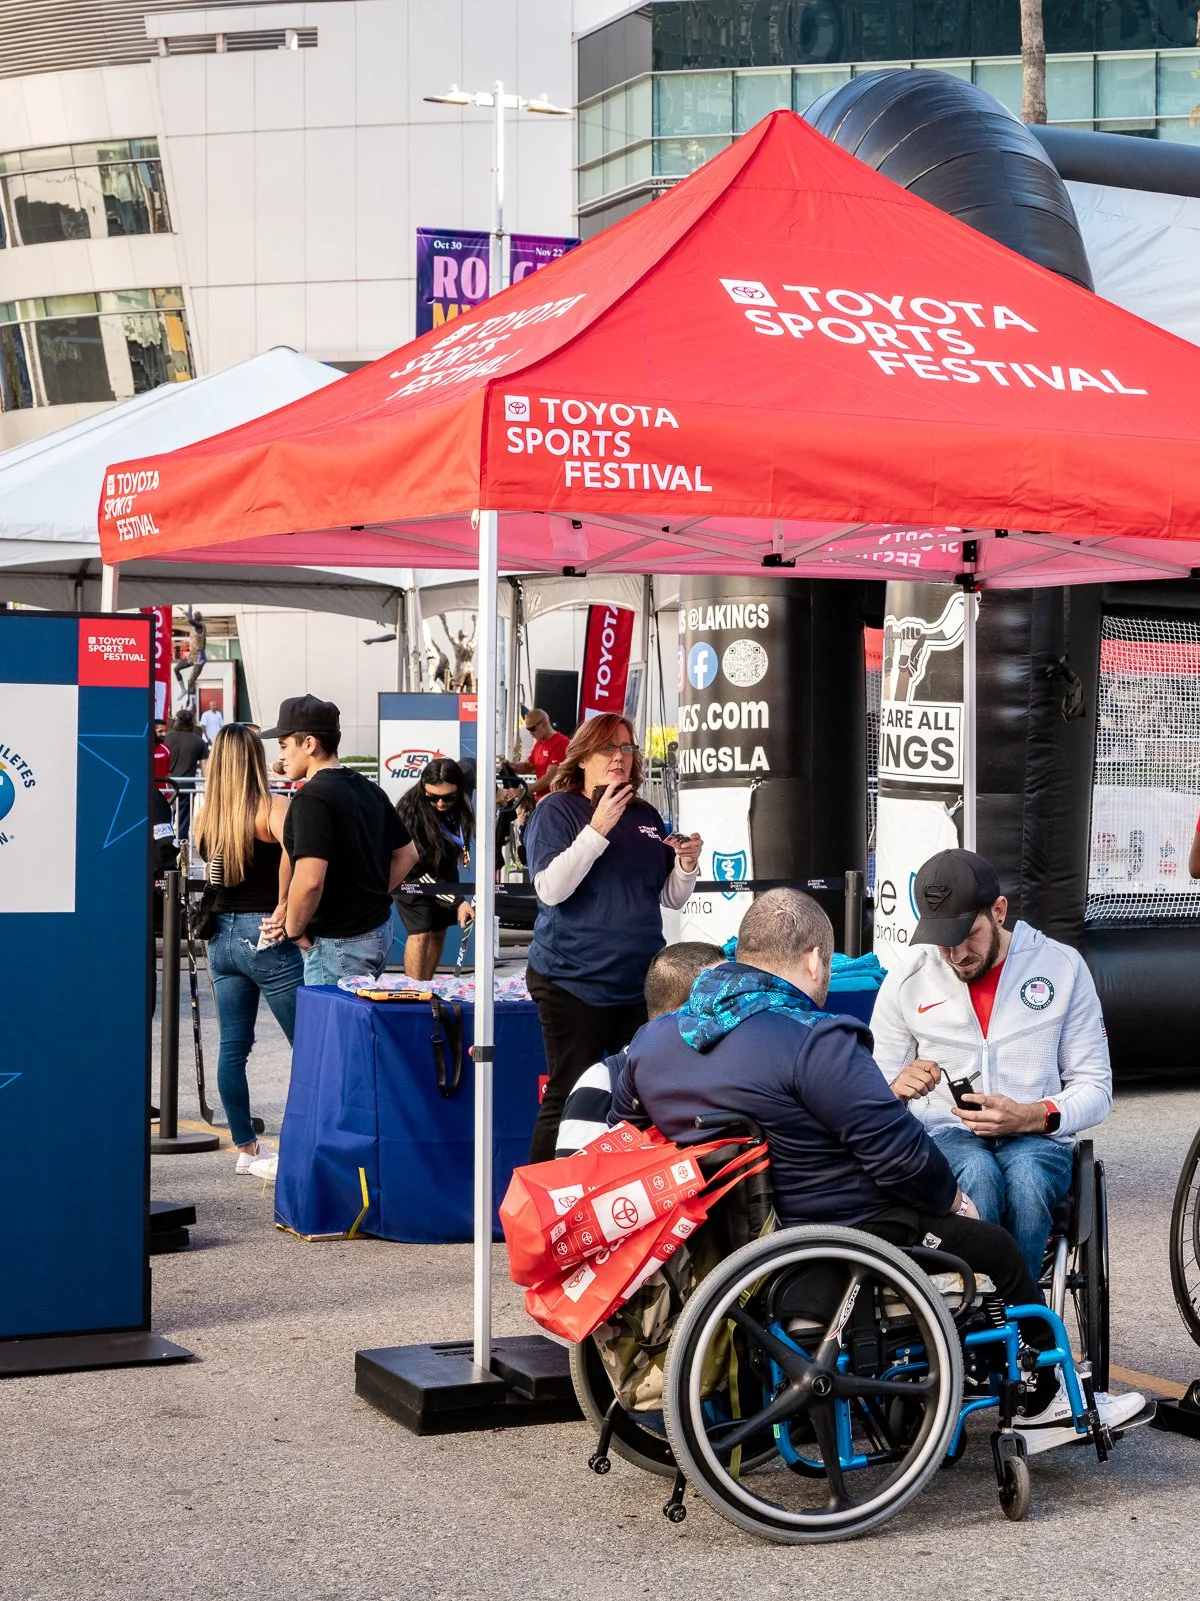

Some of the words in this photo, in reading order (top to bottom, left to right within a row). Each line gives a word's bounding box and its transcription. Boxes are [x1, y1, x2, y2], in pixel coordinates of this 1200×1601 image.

[433, 240, 448, 250] Oct
[450, 241, 462, 250] 30
[535, 247, 551, 256] Nov
[552, 248, 563, 257] 22
[461, 293, 587, 343] TOYOTA
[782, 284, 1038, 333] TOYOTA
[744, 309, 975, 355] SPORTS
[389, 334, 511, 379] SPORTS
[385, 349, 523, 401] FESTIVAL
[867, 349, 1149, 395] FESTIVAL
[538, 398, 680, 429] TOYOTA
[506, 426, 631, 457] SPORTS
[117, 470, 160, 494] TOYOTA
[564, 460, 713, 493] FESTIVAL
[104, 494, 138, 520] SPORTS
[116, 513, 160, 542] FESTIVAL
[688, 604, 770, 632] @LAKINGS
[88, 644, 124, 653] SPORTS
[98, 636, 136, 646] TOYOTA
[104, 652, 146, 662] FESTIVAL
[886, 709, 913, 729] ARE
[918, 711, 955, 731] ALL
[880, 734, 954, 772] INGS
